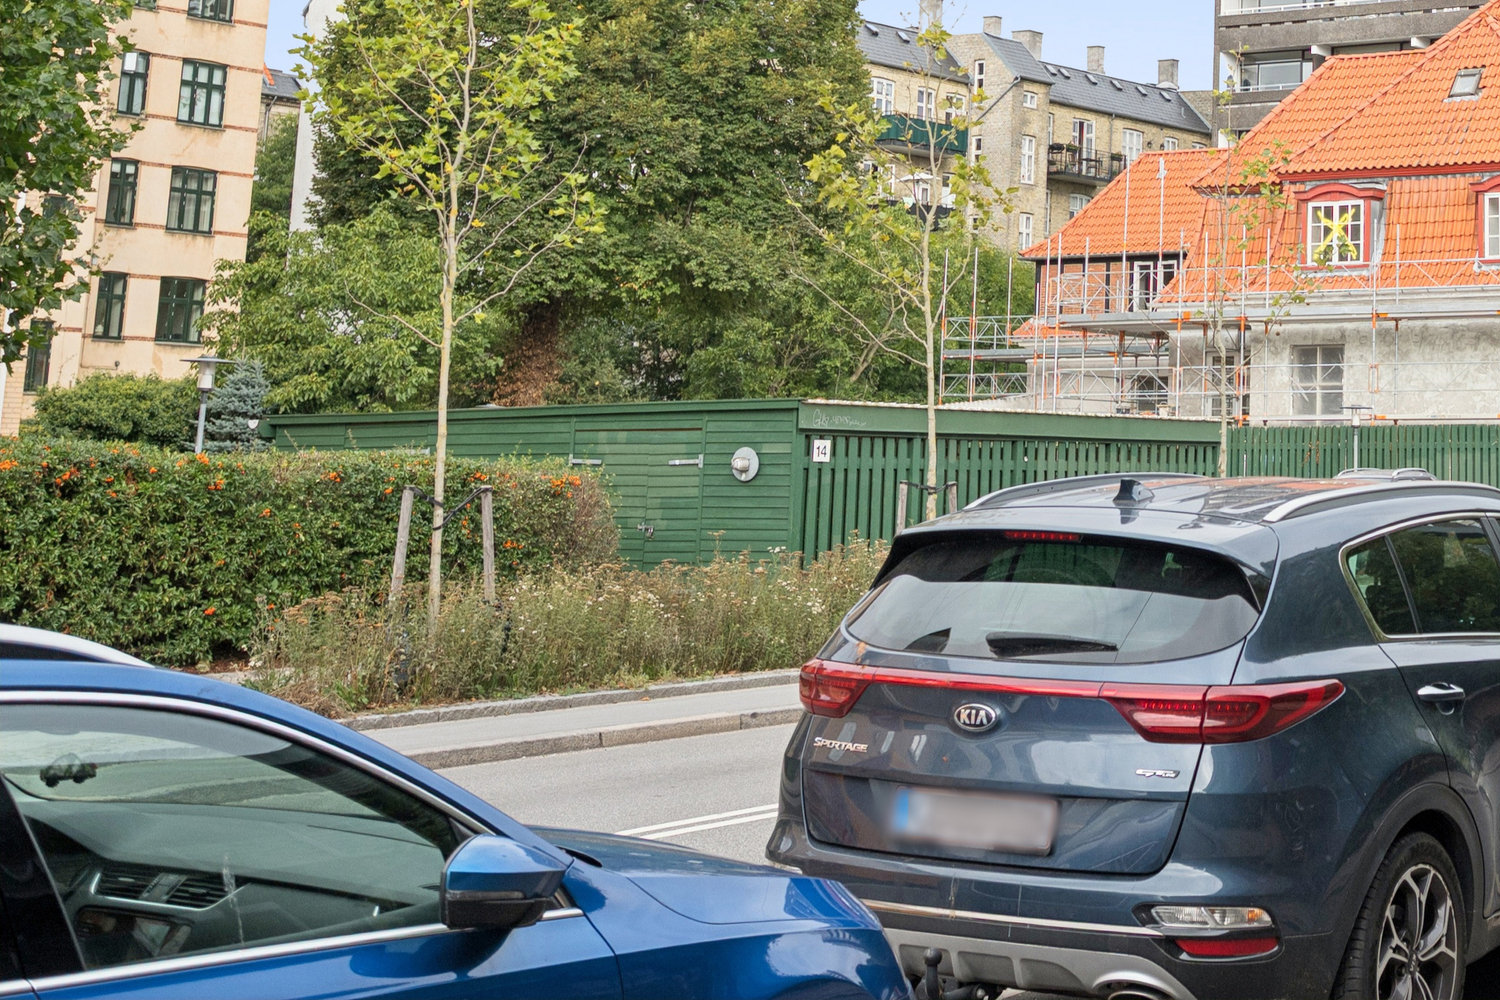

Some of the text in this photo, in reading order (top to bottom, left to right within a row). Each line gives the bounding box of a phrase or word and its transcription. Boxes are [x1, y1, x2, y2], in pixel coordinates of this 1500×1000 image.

[816, 445, 827, 457] 14
[960, 708, 988, 725] KIA
[813, 736, 868, 752] SPORTAGE
